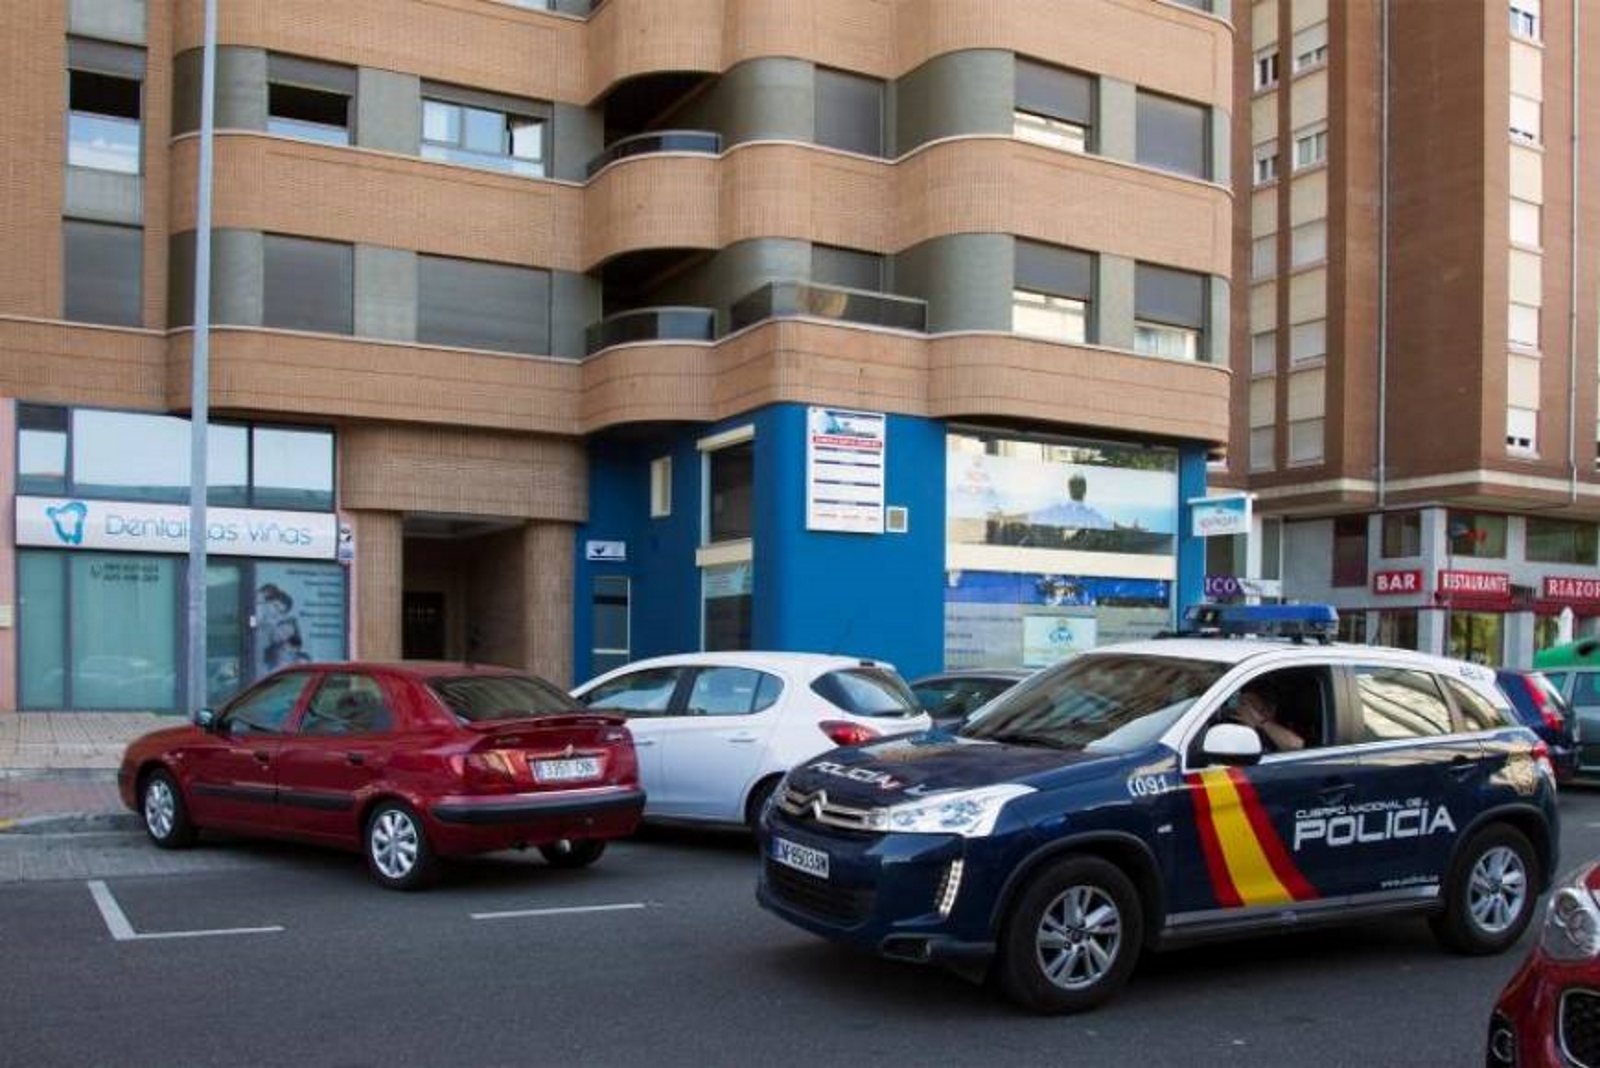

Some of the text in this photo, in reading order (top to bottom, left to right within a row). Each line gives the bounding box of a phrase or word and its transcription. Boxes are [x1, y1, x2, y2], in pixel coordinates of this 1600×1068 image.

[206, 522, 238, 541] as
[1376, 574, 1416, 591] BAR
[1443, 573, 1507, 591] RESTAURANTE
[1296, 797, 1421, 818] CUERPO NACIONAL DE
